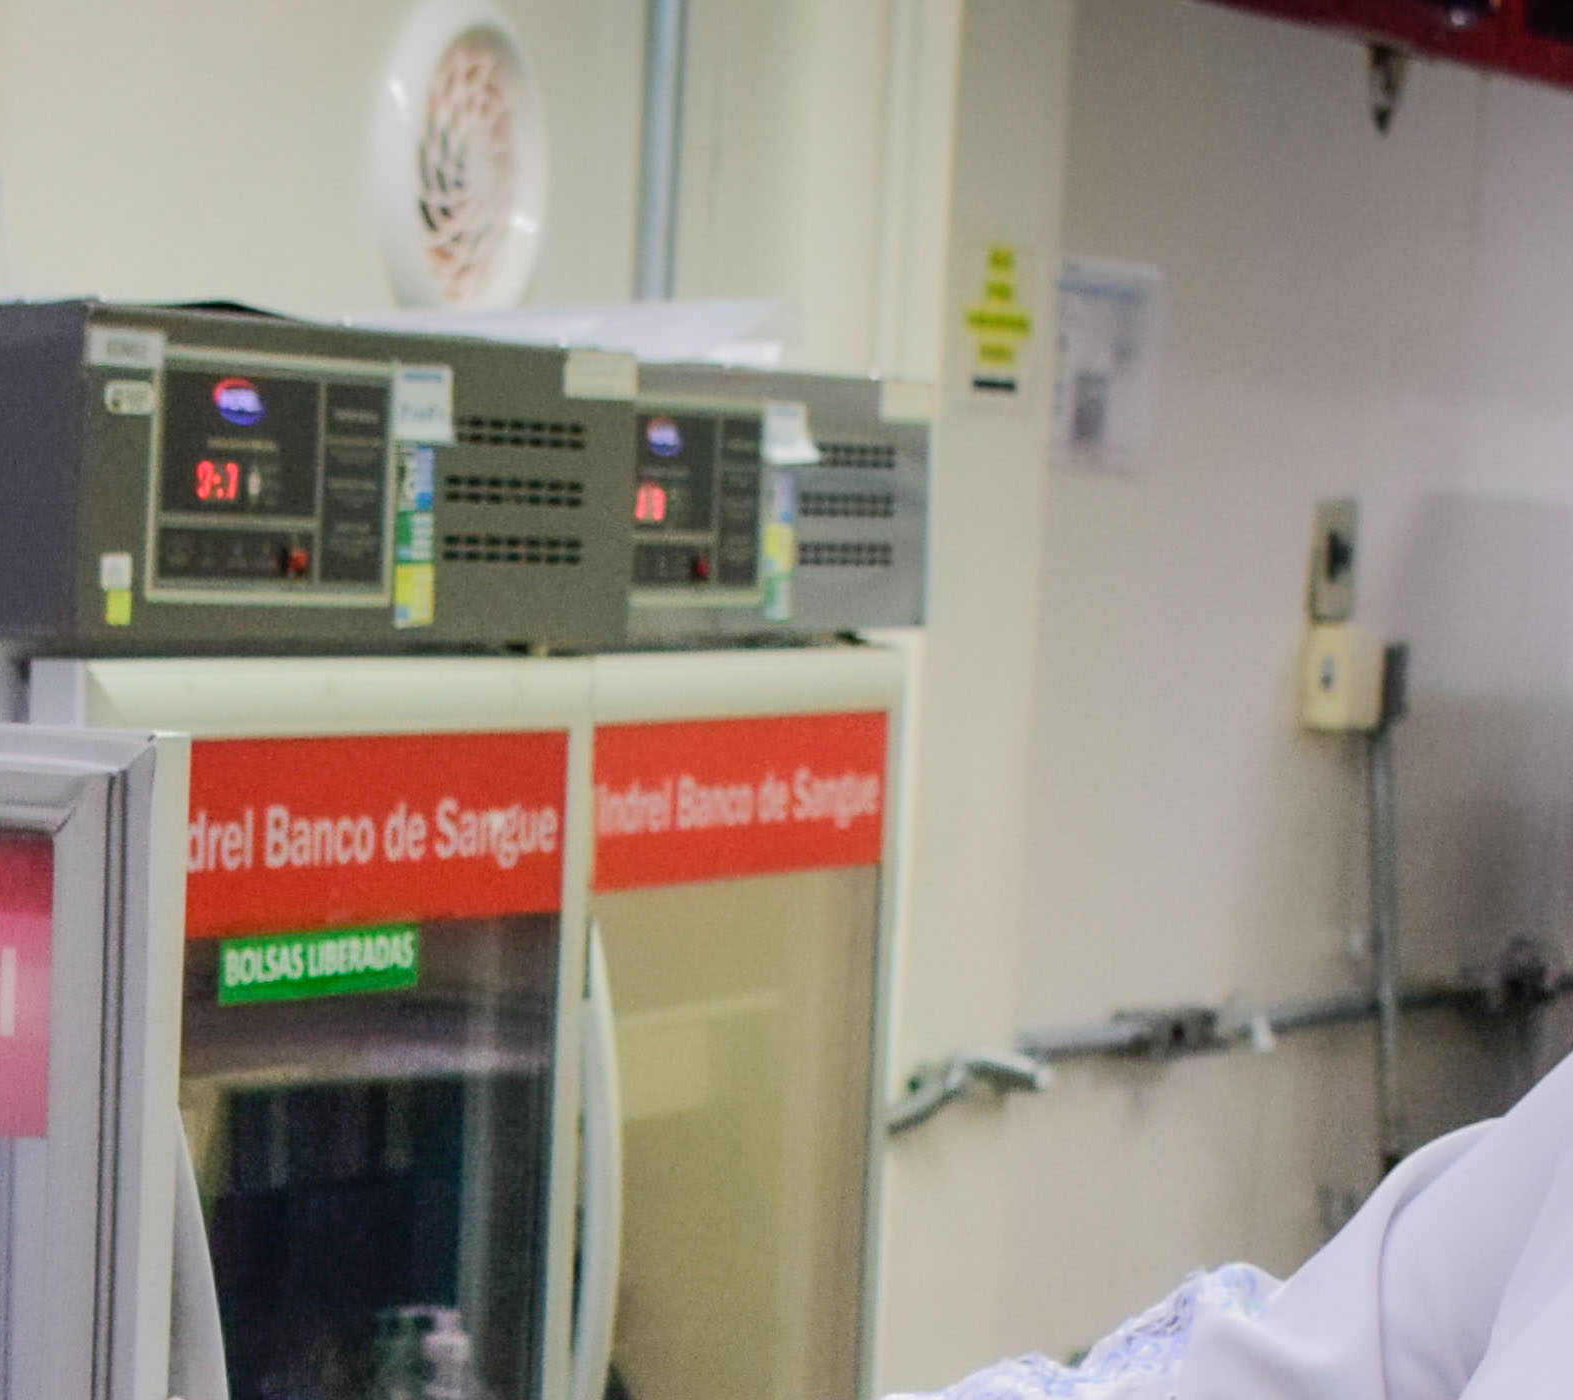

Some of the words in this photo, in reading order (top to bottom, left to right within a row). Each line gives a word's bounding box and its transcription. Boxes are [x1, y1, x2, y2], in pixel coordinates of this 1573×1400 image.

[676, 773, 754, 832] Banco
[756, 768, 791, 824] de
[792, 765, 881, 830] Sangue
[186, 807, 254, 873] drel
[265, 803, 376, 869] Banco
[384, 800, 429, 862] de
[435, 796, 559, 869] Sangue
[223, 942, 304, 988] BOLSAS
[306, 930, 416, 980] LIBERADAS
